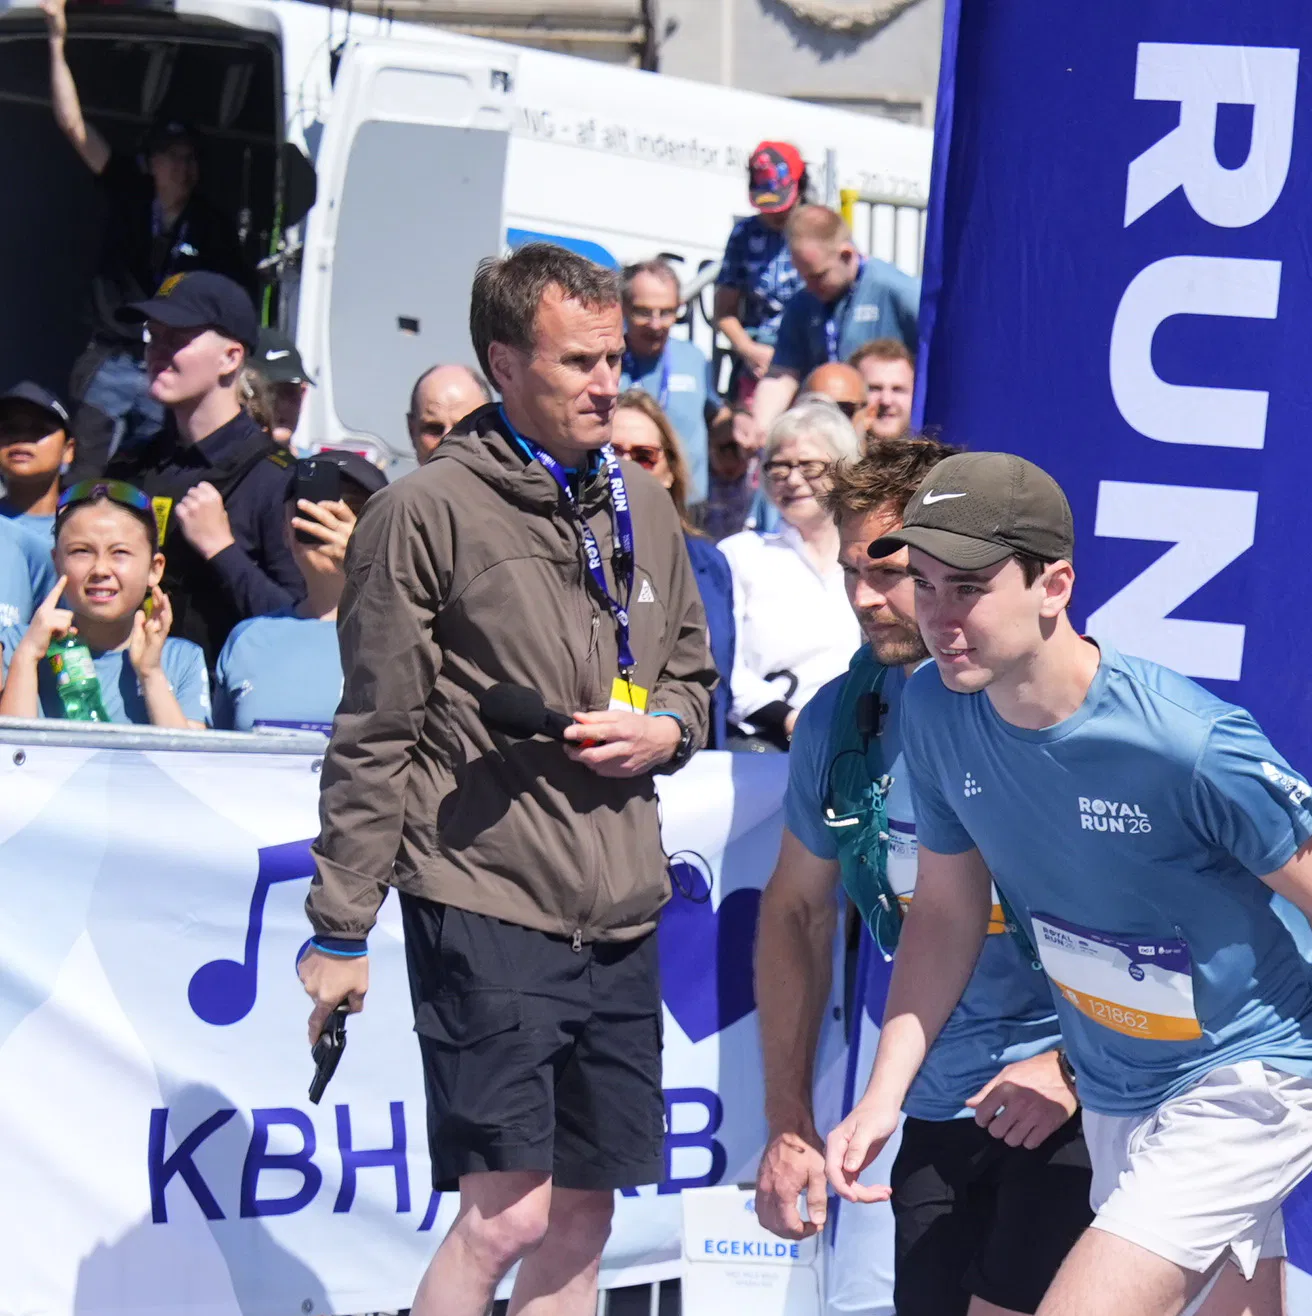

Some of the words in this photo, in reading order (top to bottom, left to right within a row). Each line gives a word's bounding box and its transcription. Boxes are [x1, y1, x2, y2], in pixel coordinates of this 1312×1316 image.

[1084, 42, 1300, 680] RUN
[609, 476, 628, 512] RUN
[1078, 796, 1148, 818] ROYAL
[1088, 999, 1149, 1030] 121862
[704, 1239, 801, 1259] EGEKILDE
